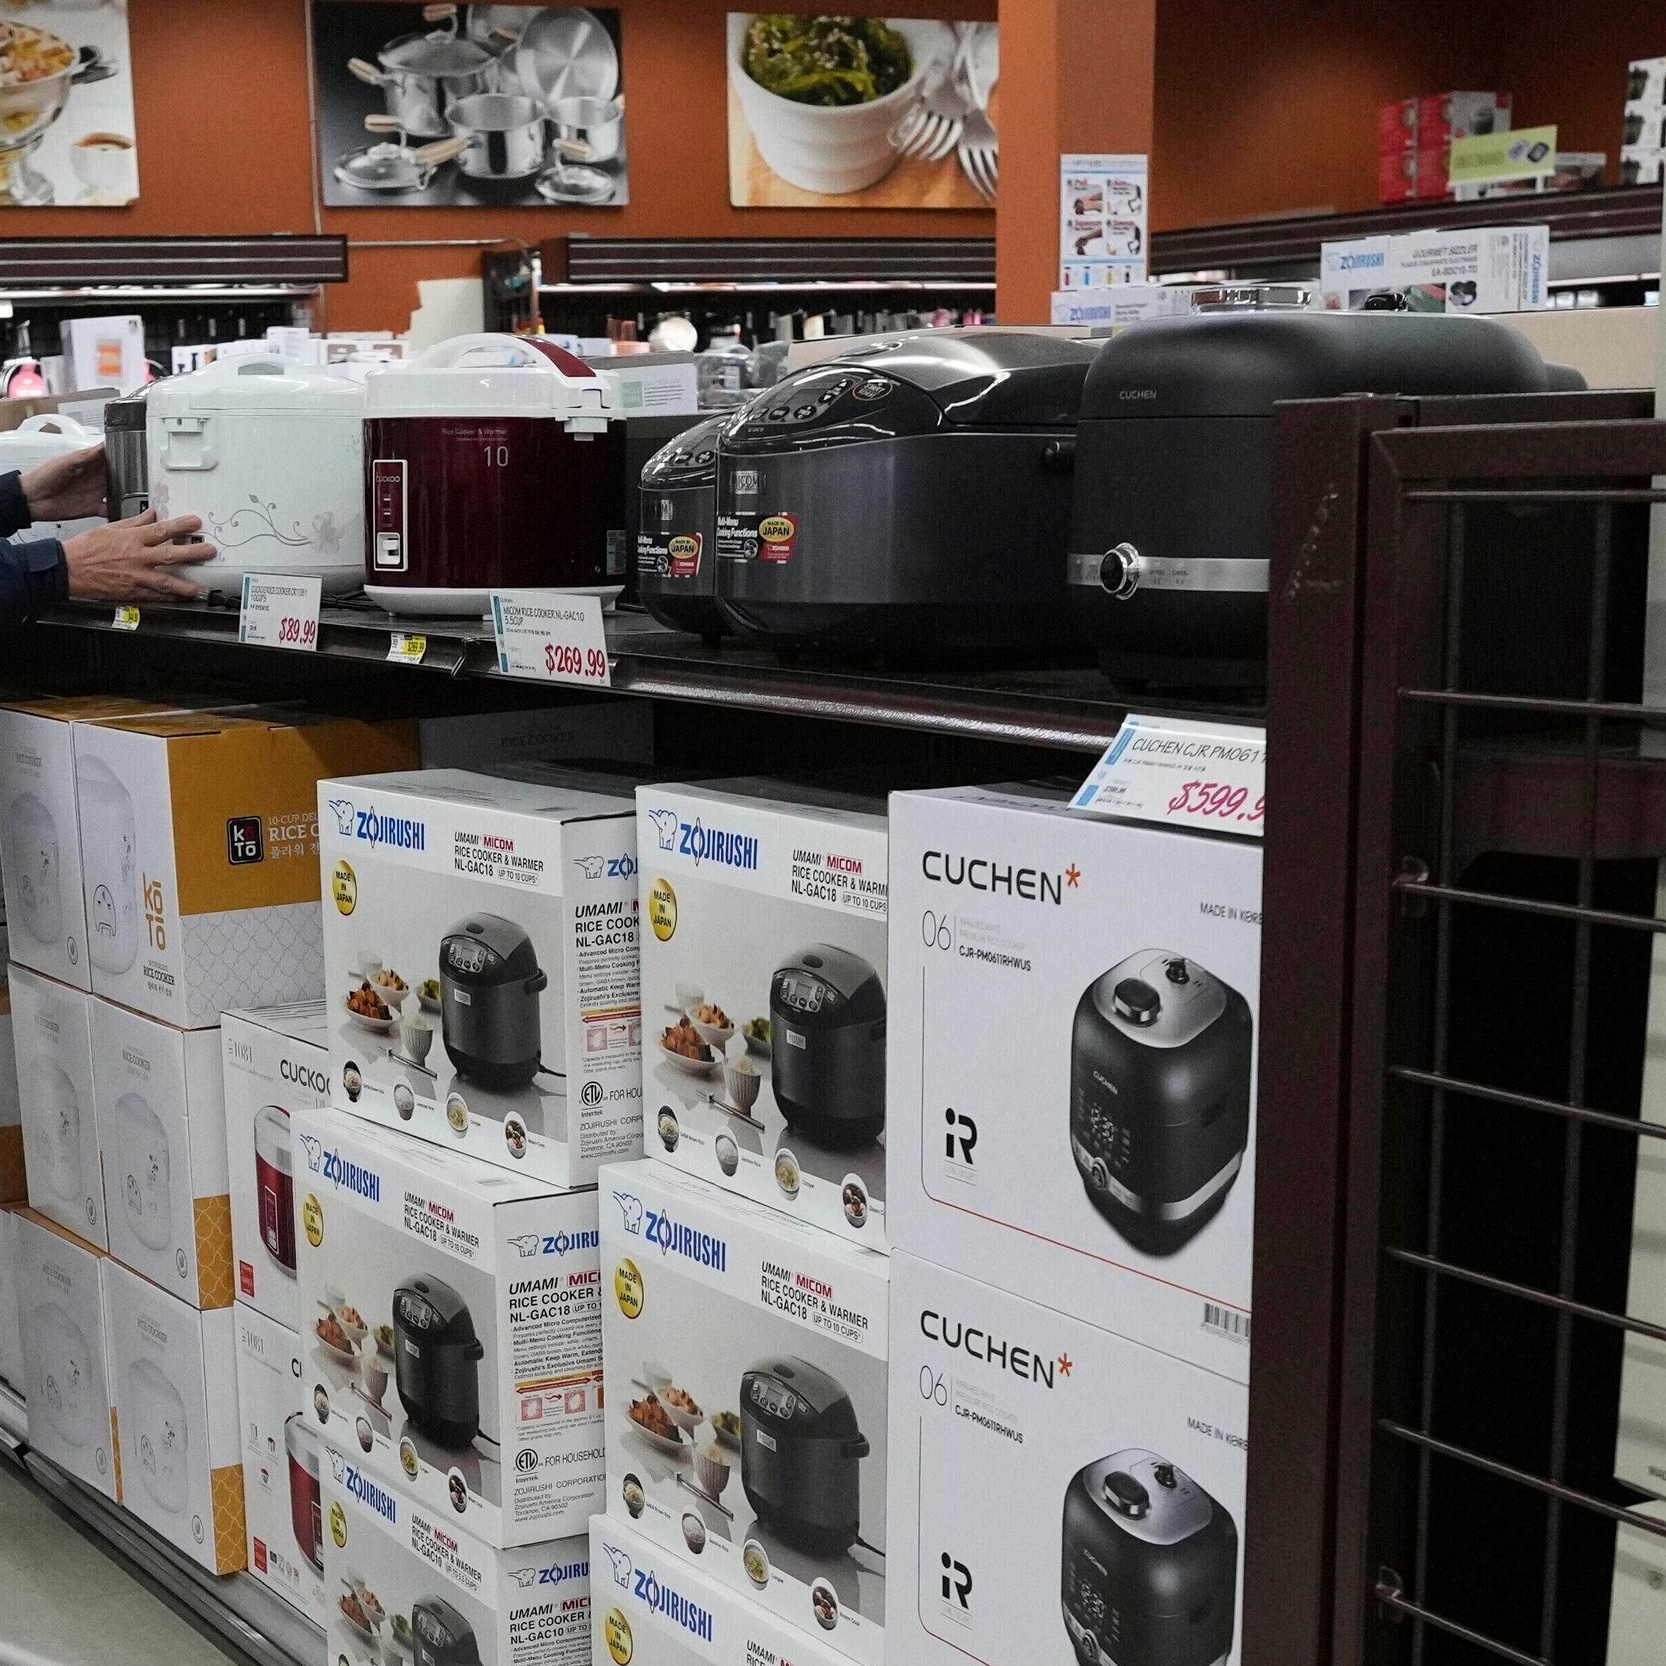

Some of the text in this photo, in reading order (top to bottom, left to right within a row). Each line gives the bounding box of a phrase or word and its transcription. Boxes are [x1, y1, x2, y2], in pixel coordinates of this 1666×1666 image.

[1120, 391, 1157, 400] CUCHEN
[484, 446, 508, 467] 10
[763, 526, 790, 537] JAPAN
[672, 544, 695, 553] JAPAN
[279, 617, 316, 644] $89.99
[545, 642, 605, 677] $269.99
[1133, 738, 1210, 757] CUCHEN CJR
[269, 825, 307, 842] RICE
[356, 805, 425, 851] ZOJIRUSHI
[454, 831, 513, 852] UMAMI MICOM
[680, 817, 758, 870] ZOJIRUSHI
[454, 845, 544, 872] RICE COOKER WARMER
[454, 858, 493, 877] NL-GAC18
[793, 849, 862, 874] UMAMI MICOM
[335, 870, 351, 882] MADE
[792, 865, 848, 888] RICE COOKER
[922, 849, 1062, 905] CUCHEN
[336, 892, 353, 905] JAPAN
[654, 889, 671, 903] MADE
[792, 880, 837, 902] NL-GAC18
[575, 901, 623, 918] UMAMI
[1200, 902, 1226, 918] MADE
[576, 919, 602, 934] RICE
[654, 915, 672, 928] JAPAN
[922, 910, 952, 952] 06
[576, 931, 634, 949] NL-GAC18
[958, 945, 1032, 972] CJR-PM0611RHWUS
[143, 965, 175, 986] RICE COOKER
[323, 1149, 380, 1202] ZOJIRUSHI
[404, 1191, 454, 1222] UMAMI MICOM
[404, 1204, 480, 1248] RICE COOKER WARMER
[404, 1217, 437, 1242] NL-GAC18
[645, 1209, 726, 1272] ZOJIRUSHI
[509, 1277, 558, 1295] UMAMI
[619, 1267, 637, 1284] MADE
[762, 1261, 833, 1298] UMAMI MICOM
[509, 1287, 594, 1309] RICE COOKER
[619, 1293, 638, 1308] JAPAN
[761, 1276, 869, 1330] RICE COOKER WARMER
[761, 1291, 807, 1321] NL-GAC18
[510, 1305, 571, 1323] NL-GAC18
[920, 1310, 1054, 1388] CUCHEN
[920, 1365, 947, 1406] 06
[955, 1405, 1023, 1444] CJR-PM0611RHWUS
[1187, 1416, 1212, 1434] MADE
[544, 1455, 560, 1467] FOR
[347, 1465, 397, 1524] ZOJIRUSHI
[514, 1483, 552, 1496] ZOJIRUSHI
[412, 1525, 425, 1545] RICE
[426, 1535, 448, 1561] COOKER
[509, 1603, 554, 1621] UMAMI
[634, 1570, 712, 1642] ZOJIRUSHI
[510, 1611, 584, 1633] RICE COOKER
[609, 1615, 626, 1634] MADE
[510, 1626, 564, 1645] NL-GAC10
[609, 1638, 627, 1656] JAPAN
[747, 1640, 775, 1665] UMAMI
